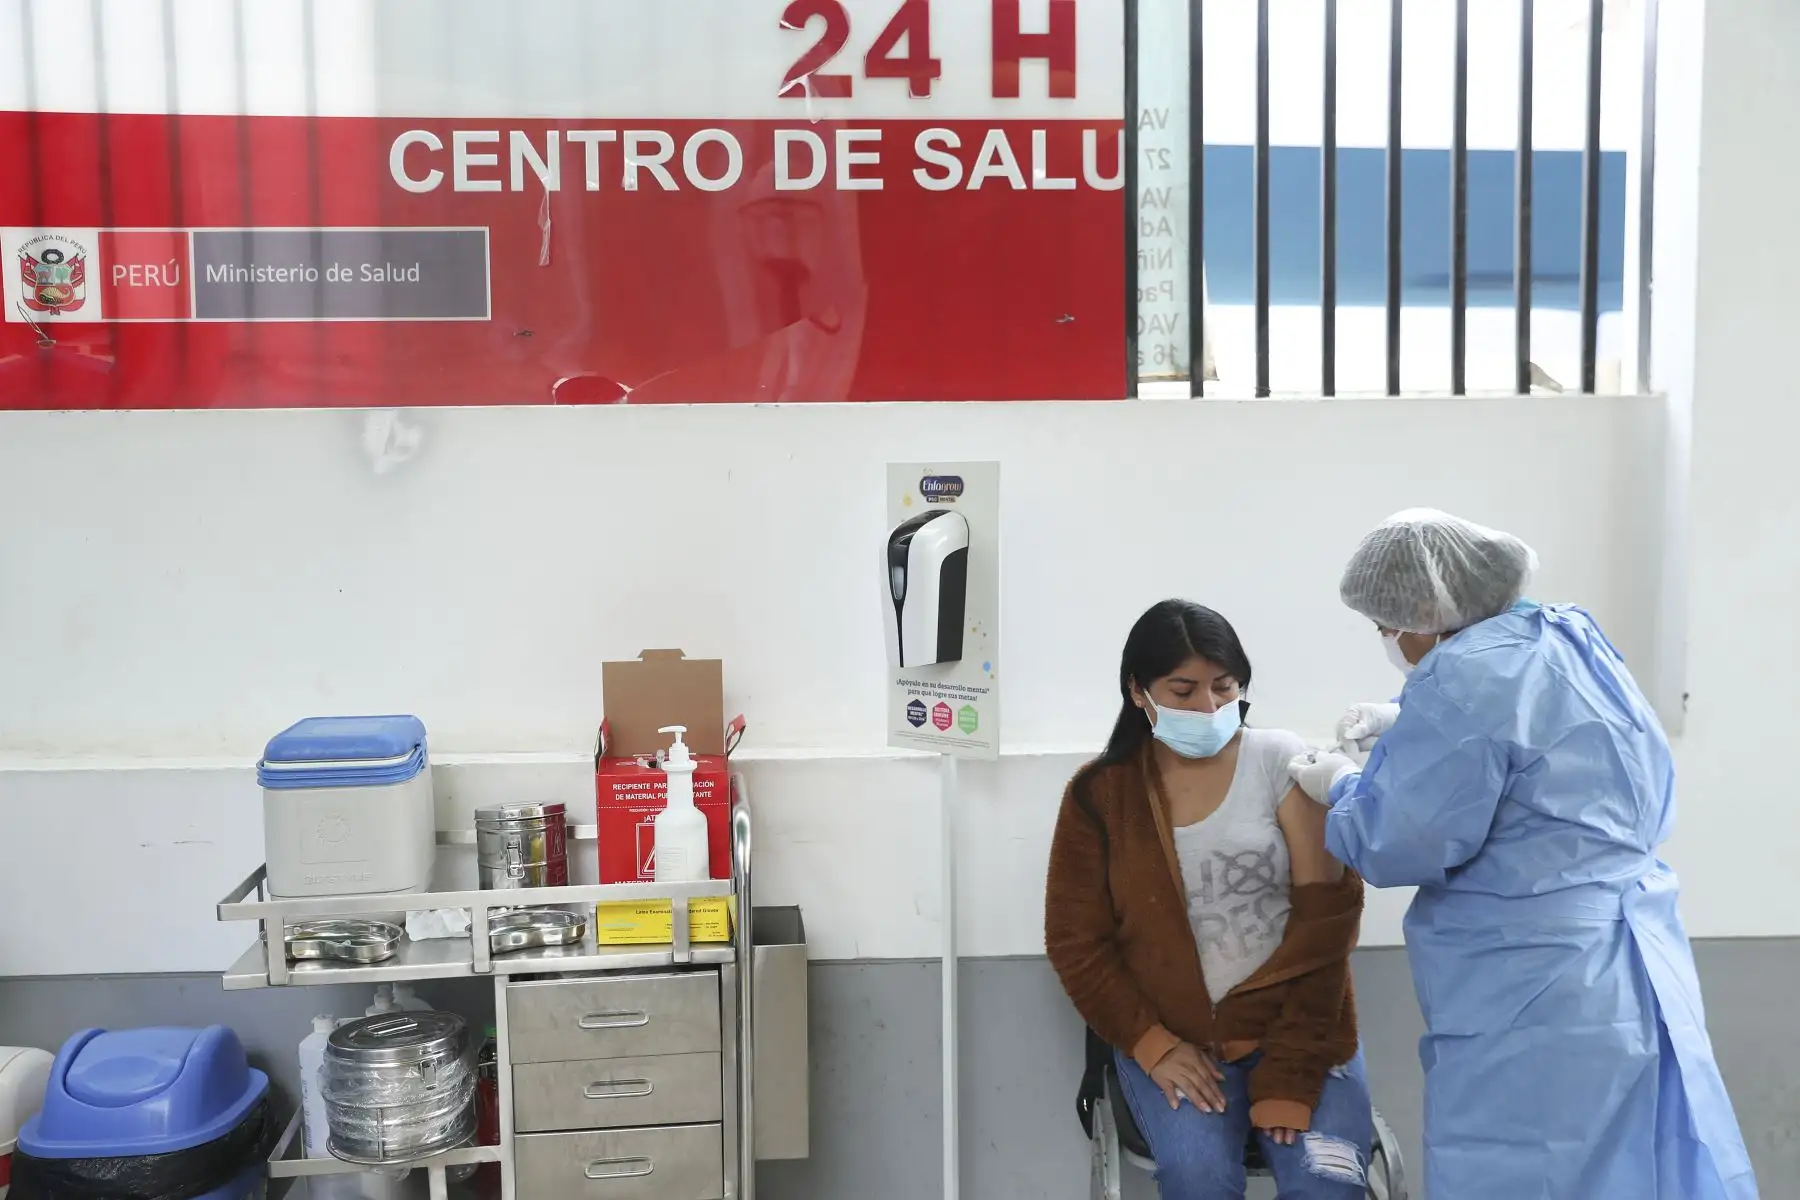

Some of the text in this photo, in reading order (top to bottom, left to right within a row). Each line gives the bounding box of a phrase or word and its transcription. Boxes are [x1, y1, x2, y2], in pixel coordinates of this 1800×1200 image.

[777, 0, 1077, 99] 24 H
[389, 127, 1125, 191] CENTRO DE SALU
[112, 259, 180, 287] PERÚ
[206, 262, 420, 283] Ministerio de Salud
[626, 792, 656, 800] MATERIAL
[654, 781, 668, 789] PAR
